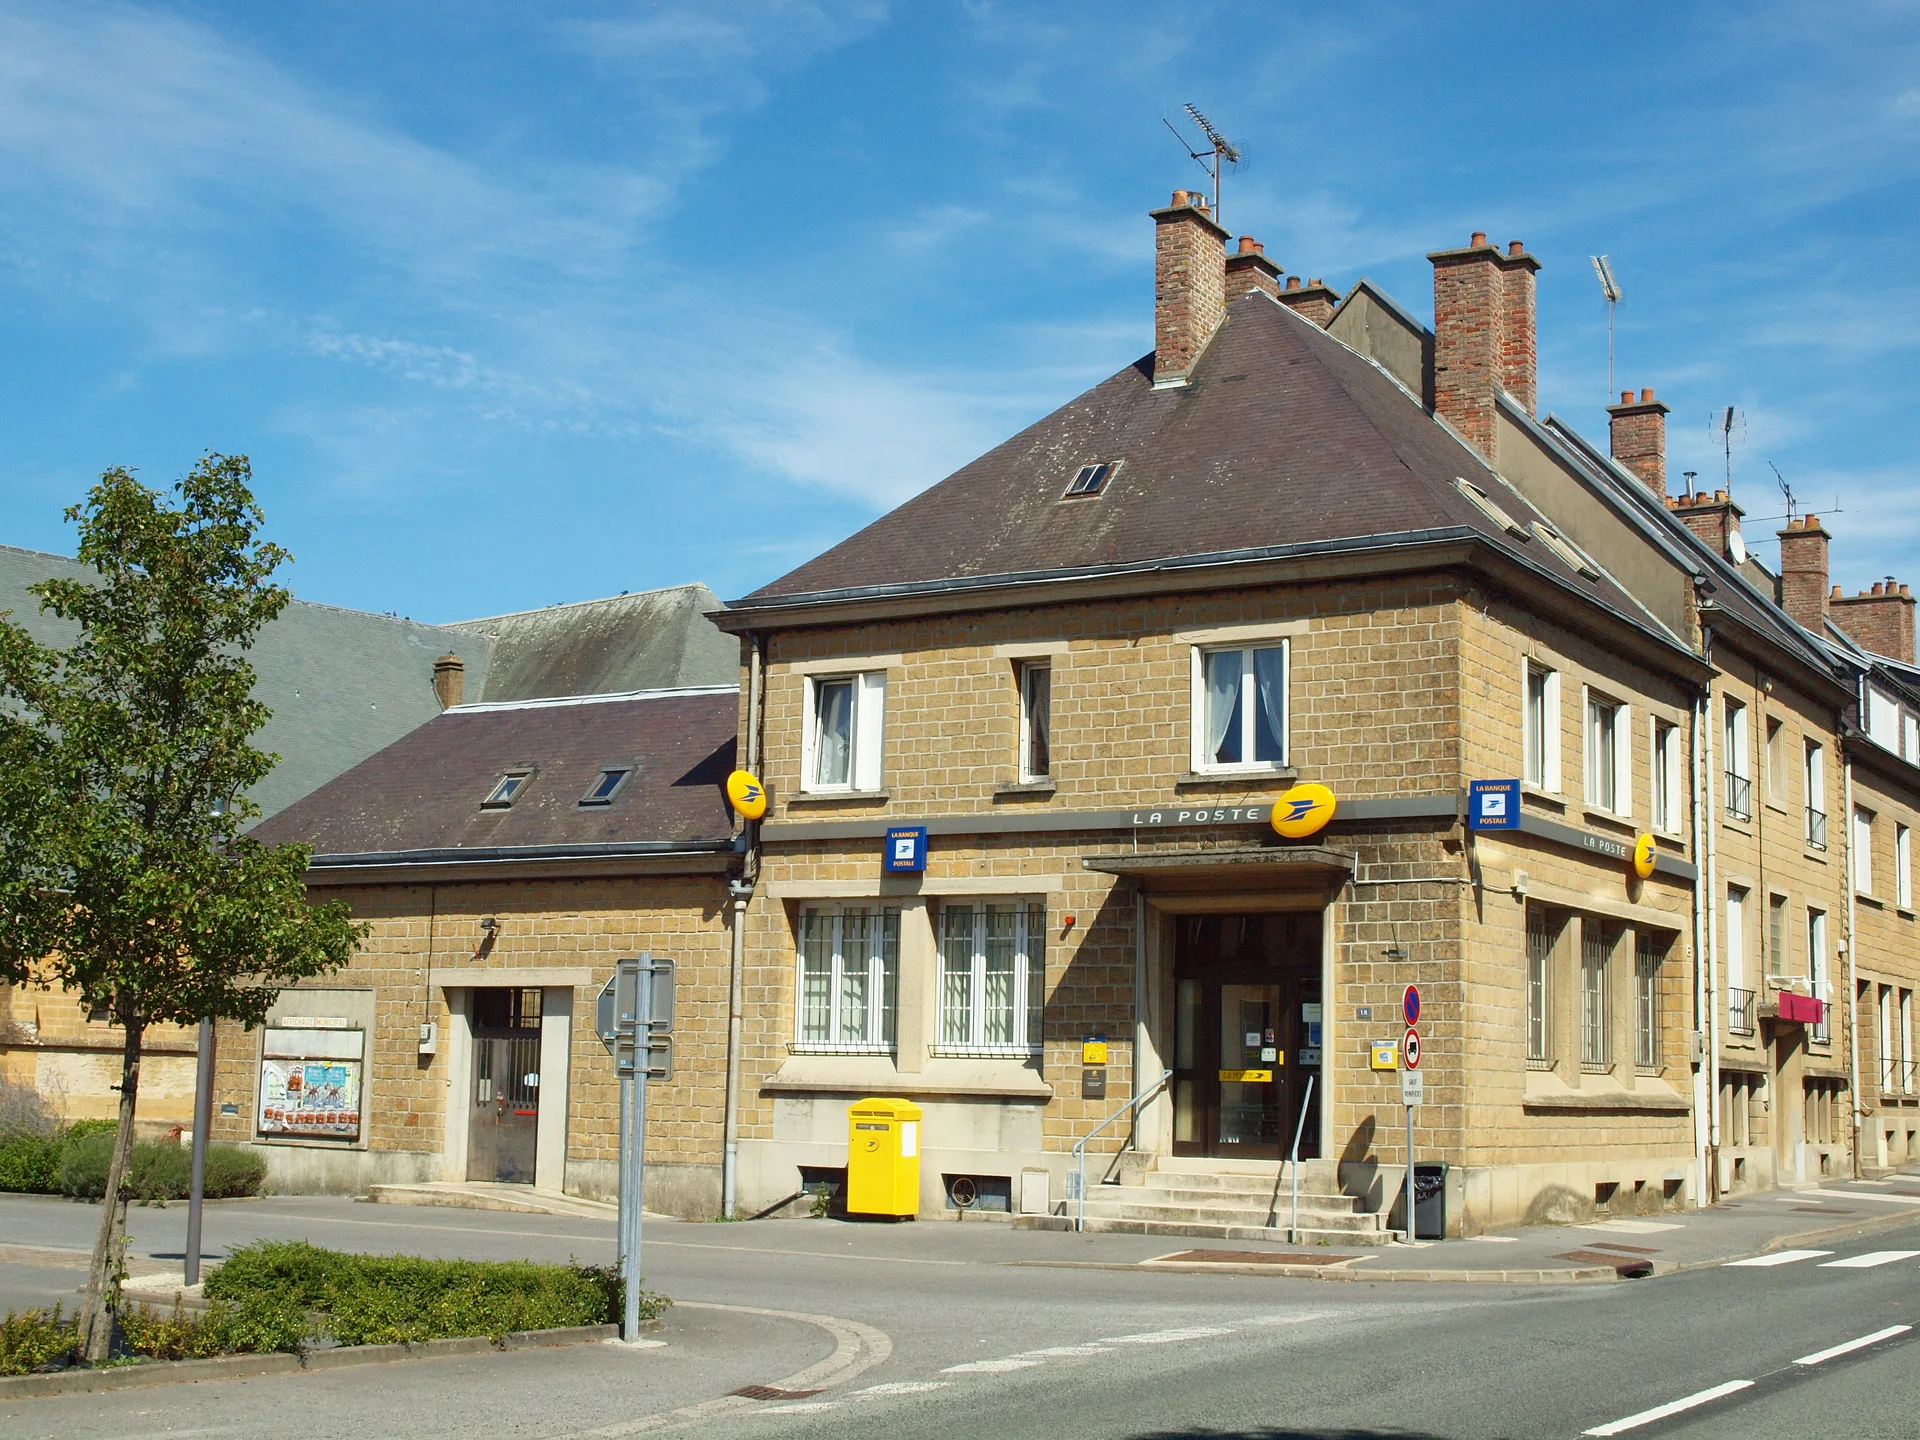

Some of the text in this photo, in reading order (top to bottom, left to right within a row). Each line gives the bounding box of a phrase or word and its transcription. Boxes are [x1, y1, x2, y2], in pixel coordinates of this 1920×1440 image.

[1485, 784, 1512, 792] BANQUE
[1133, 808, 1260, 824] LA POSTE
[1583, 835, 1626, 857] LA POSTE
[283, 1018, 345, 1026] AFFICHAGE MUNICIPAL
